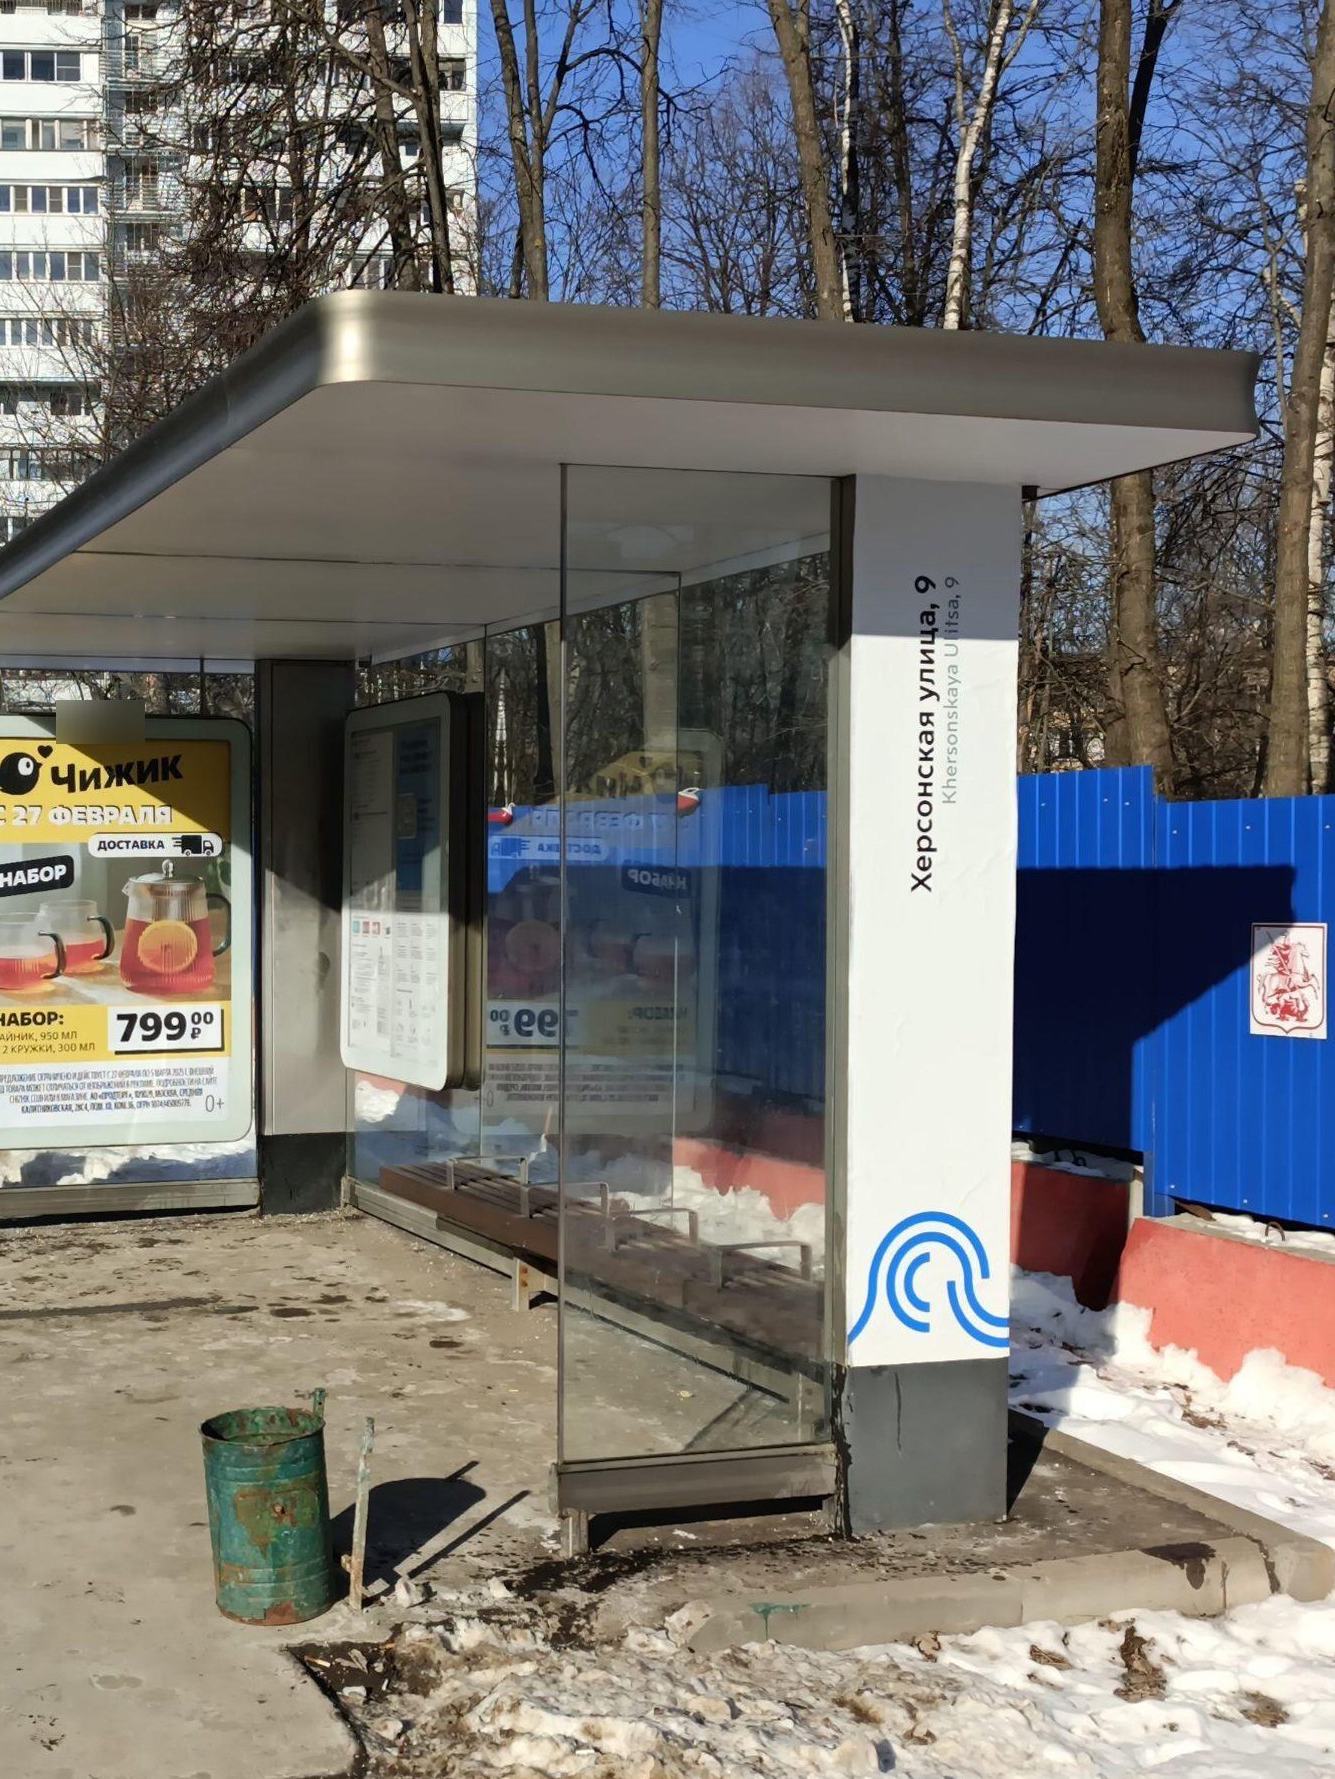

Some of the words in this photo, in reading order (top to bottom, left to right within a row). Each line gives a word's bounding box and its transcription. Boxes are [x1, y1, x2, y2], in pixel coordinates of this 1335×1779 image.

[914, 575, 937, 594] 9
[944, 576, 959, 588] 9
[919, 603, 940, 702] улица,
[942, 664, 962, 804] Khersonskaya
[911, 711, 938, 893] Херсонская
[12, 804, 42, 826] 27
[48, 804, 173, 826] ФЕВРАЛЯ
[97, 840, 165, 851] ДОСТАВКА
[40, 1032, 59, 1041] 950
[61, 1031, 77, 1040] МЛ
[116, 1011, 187, 1042] 799
[191, 1011, 214, 1026] 00
[3, 1045, 9, 1054] 2
[11, 1043, 55, 1054] КРУЖКИ,
[58, 1043, 79, 1052] 300
[81, 1042, 95, 1051] МЛ
[205, 1094, 224, 1112] 0+
